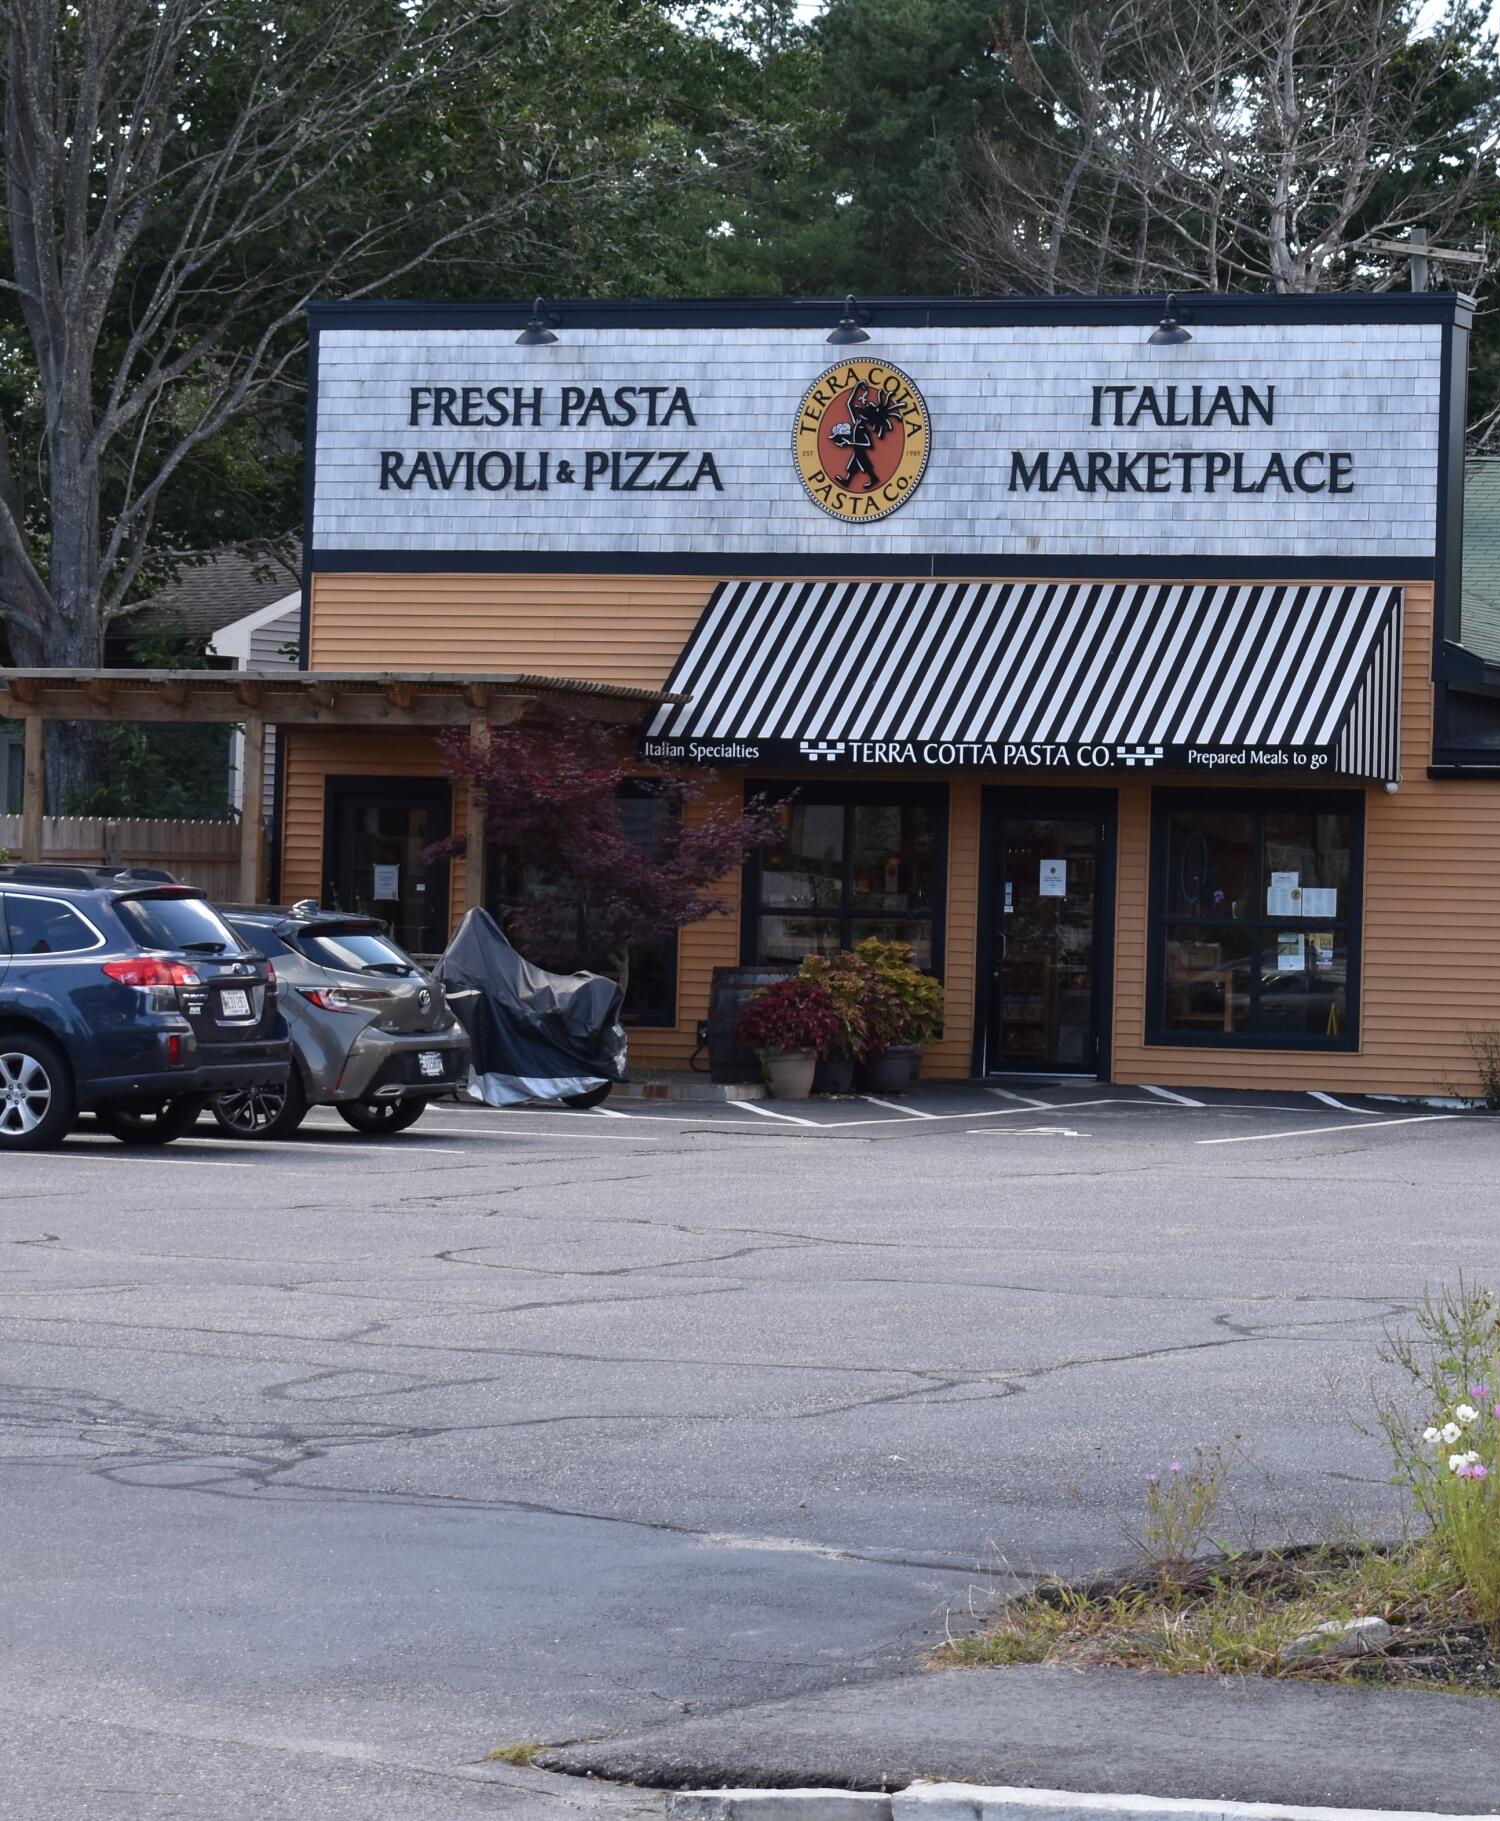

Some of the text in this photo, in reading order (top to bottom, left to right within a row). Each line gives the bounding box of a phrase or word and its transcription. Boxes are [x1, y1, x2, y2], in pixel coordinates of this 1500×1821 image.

[409, 386, 697, 427] FRESH PASTA
[799, 367, 923, 438] TERRA COTTA
[1090, 385, 1276, 427] ITALIAN
[379, 450, 725, 492] RAVIOLI & PIZZA
[808, 470, 881, 514] PASTA
[1007, 451, 1355, 494] MARKETPLACE
[645, 742, 760, 762] Italian Specialties
[848, 742, 1115, 767] TERRA COTTA PASTA CO.
[1188, 749, 1328, 770] Prepared Meals to go
